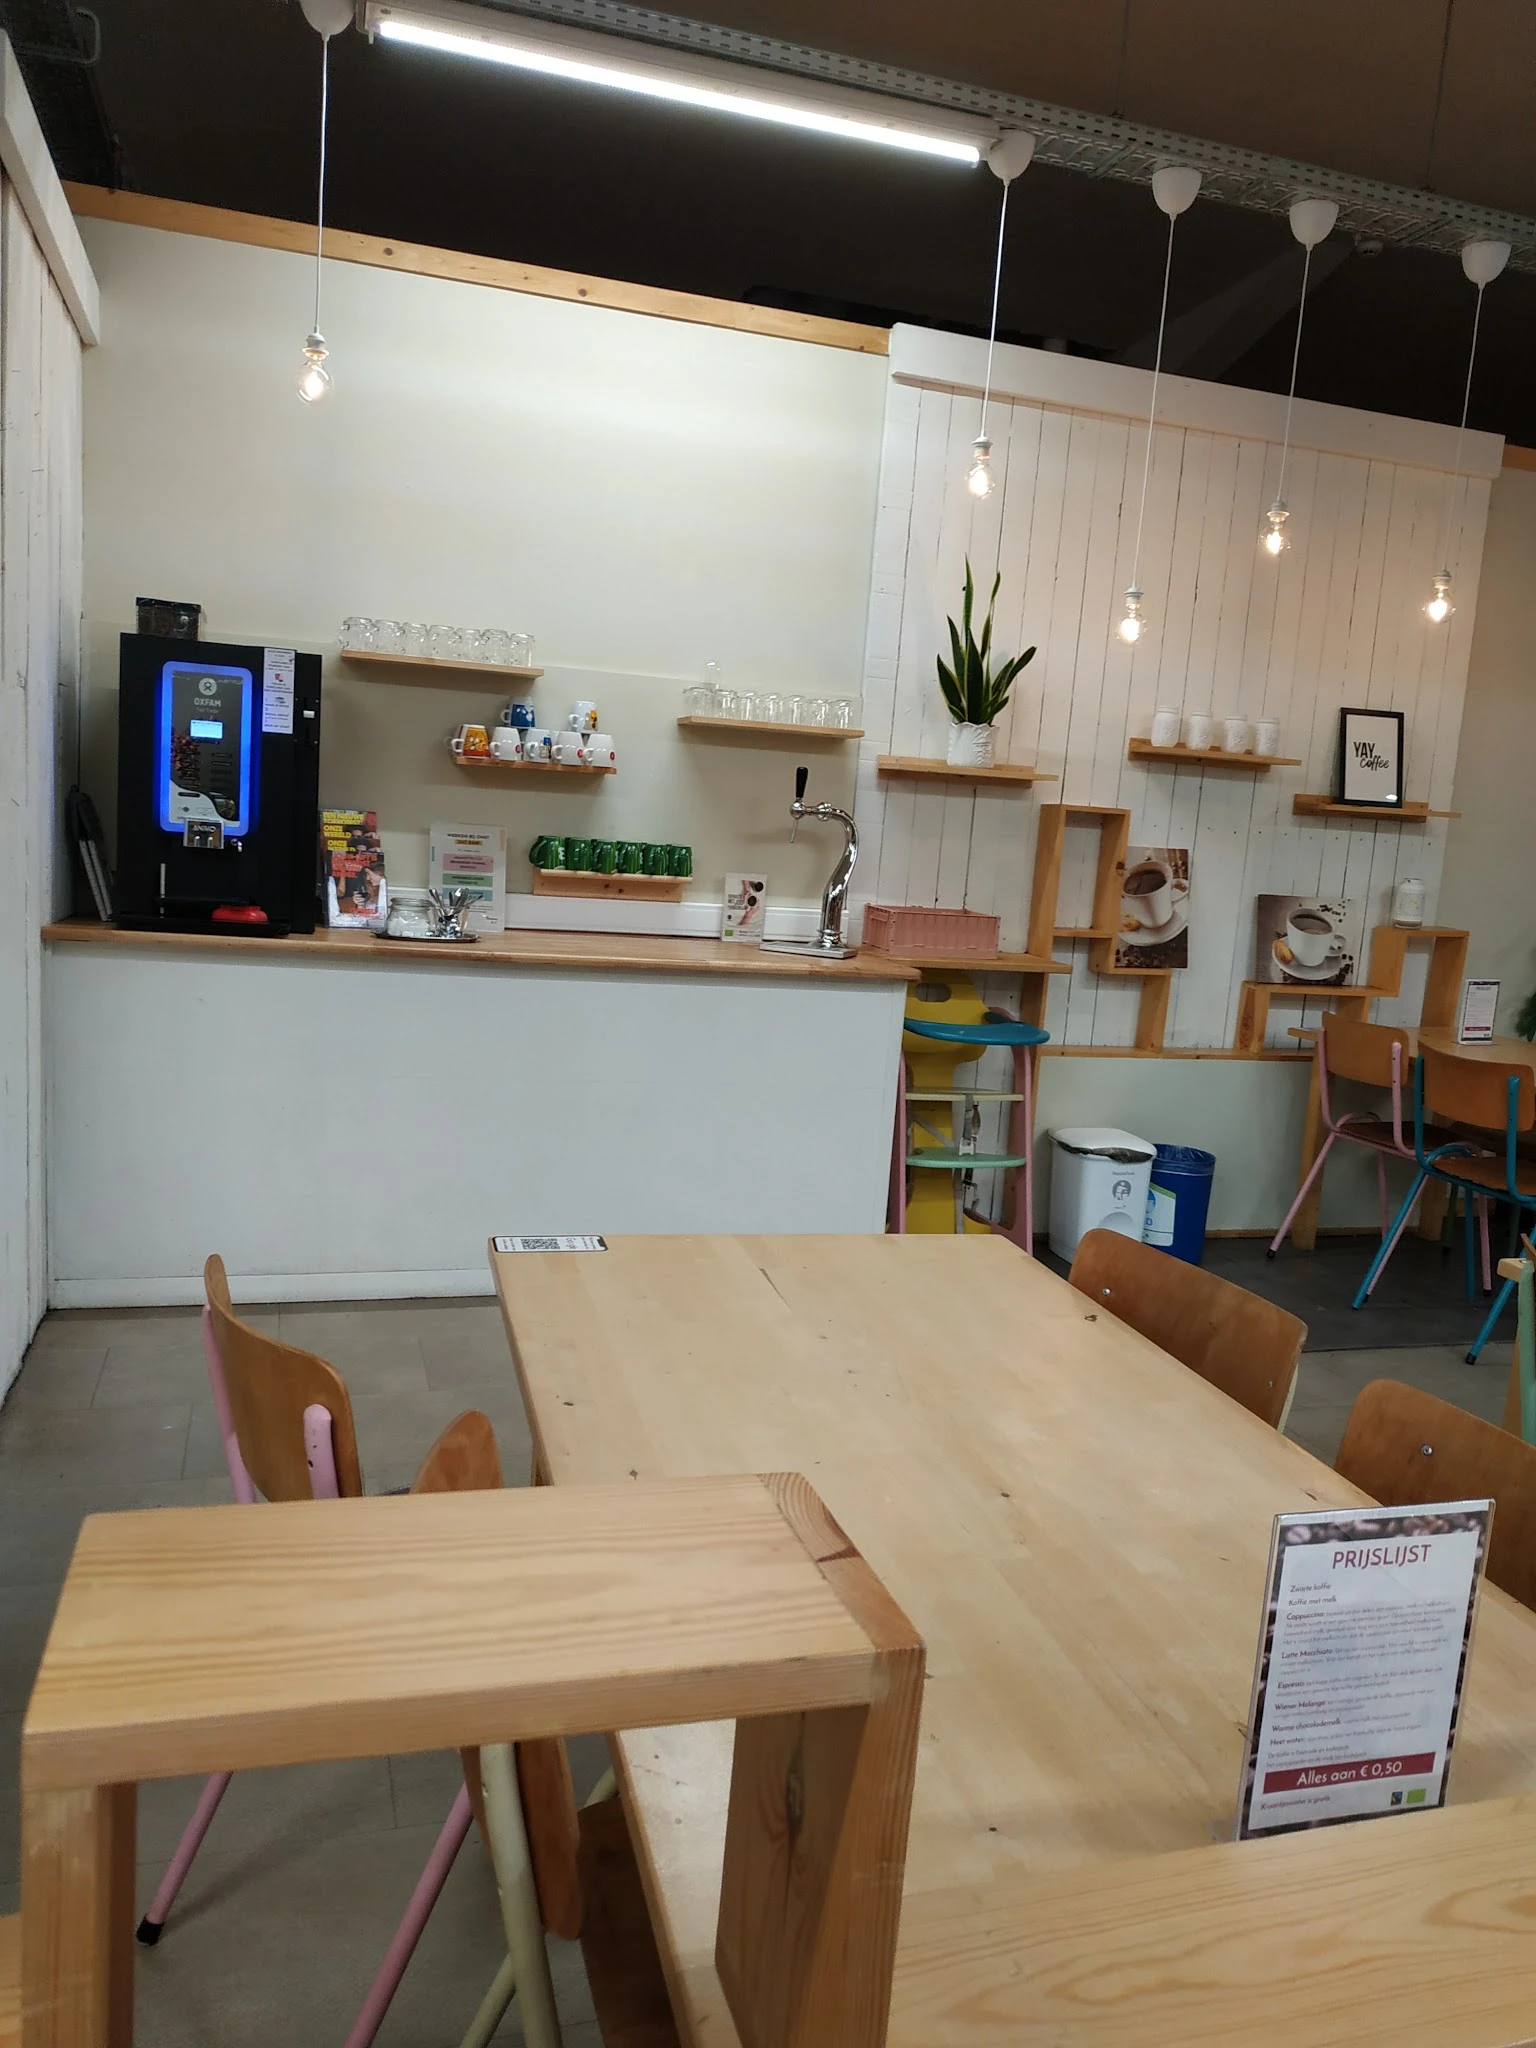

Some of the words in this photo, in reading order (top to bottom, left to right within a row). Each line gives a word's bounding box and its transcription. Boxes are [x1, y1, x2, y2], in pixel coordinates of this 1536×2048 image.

[194, 697, 221, 707] OXFAM
[1353, 742, 1375, 758] YAY
[1332, 1544, 1431, 1570] PRIJSLIJST
[1290, 1585, 1312, 1593] Zwarte
[1313, 1582, 1331, 1591] koffie
[1288, 1598, 1307, 1606] Koffie
[1322, 1595, 1337, 1603] melk
[1296, 1768, 1327, 1786] Alles
[1331, 1769, 1356, 1781] aan
[1360, 1765, 1369, 1777] €
[1372, 1761, 1403, 1778] 0,50
